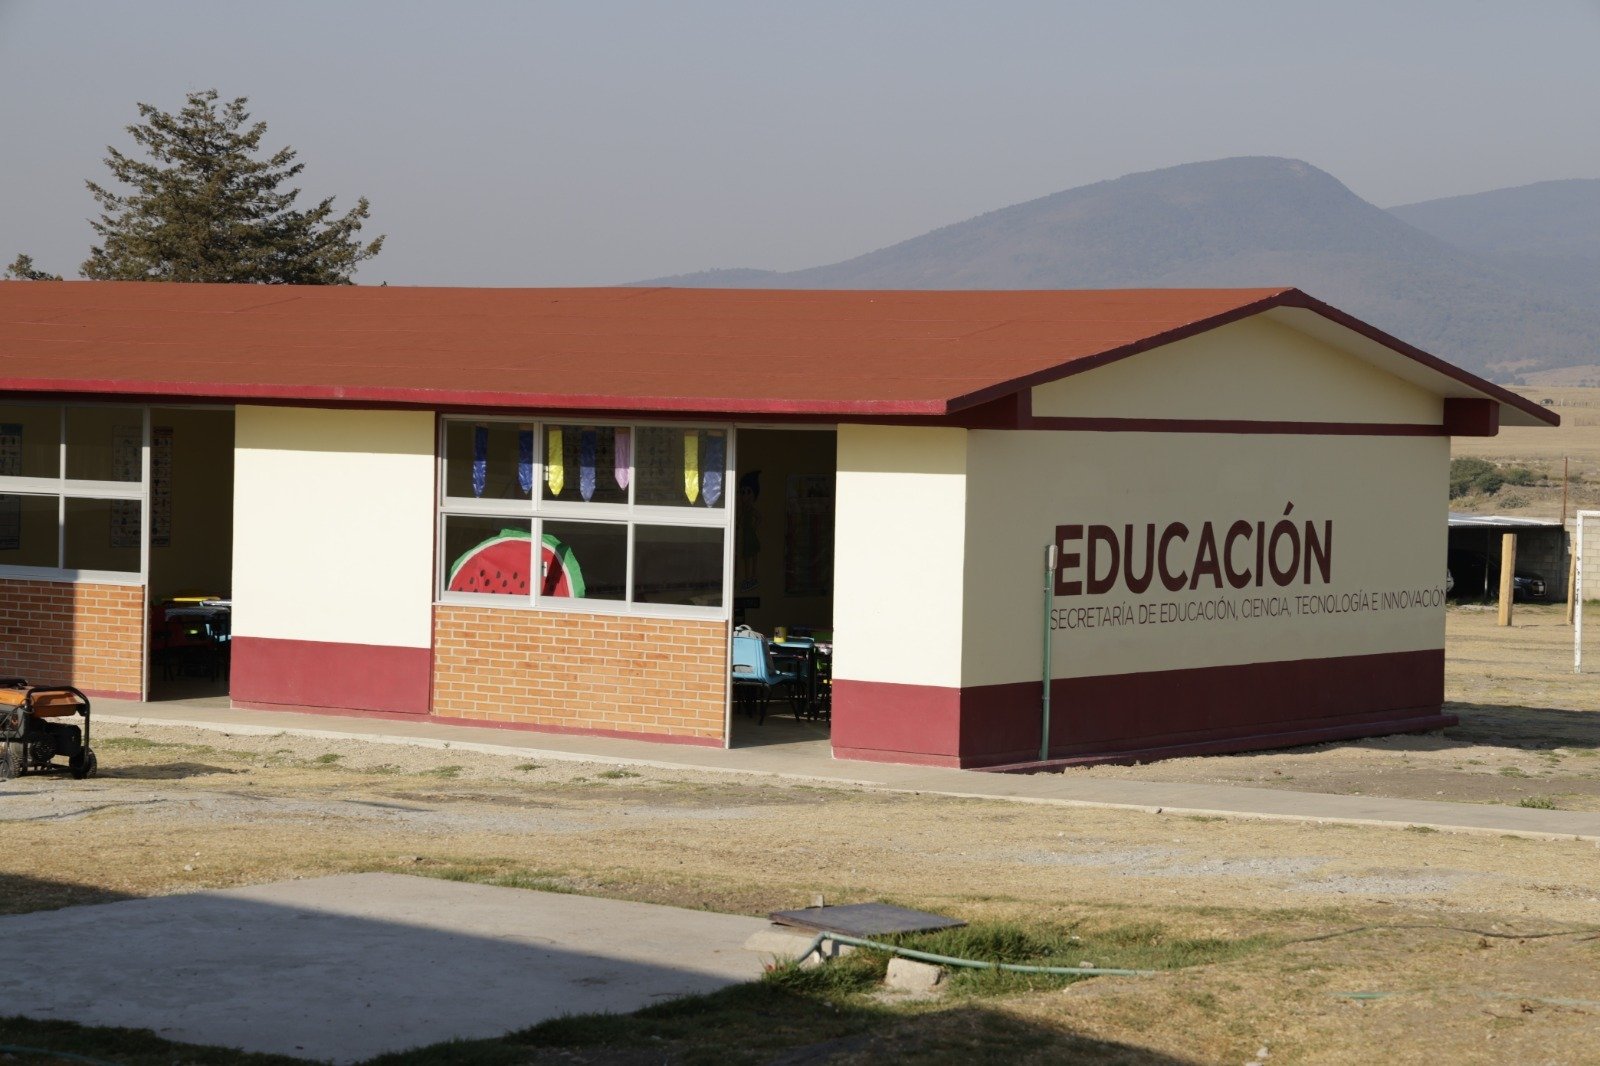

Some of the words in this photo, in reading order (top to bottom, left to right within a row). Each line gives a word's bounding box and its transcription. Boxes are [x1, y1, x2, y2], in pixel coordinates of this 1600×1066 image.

[1055, 501, 1332, 596] EDUCACIÓN
[1050, 601, 1134, 630] SECRETARÍA
[1138, 603, 1157, 624] DE
[1160, 596, 1238, 623] EDUCACIÓN,
[1242, 598, 1291, 618] CIENCIA,
[1295, 589, 1369, 614] TECNOLOGÍA
[1371, 593, 1379, 612] E
[1382, 586, 1446, 611] INNOVACIÓN
